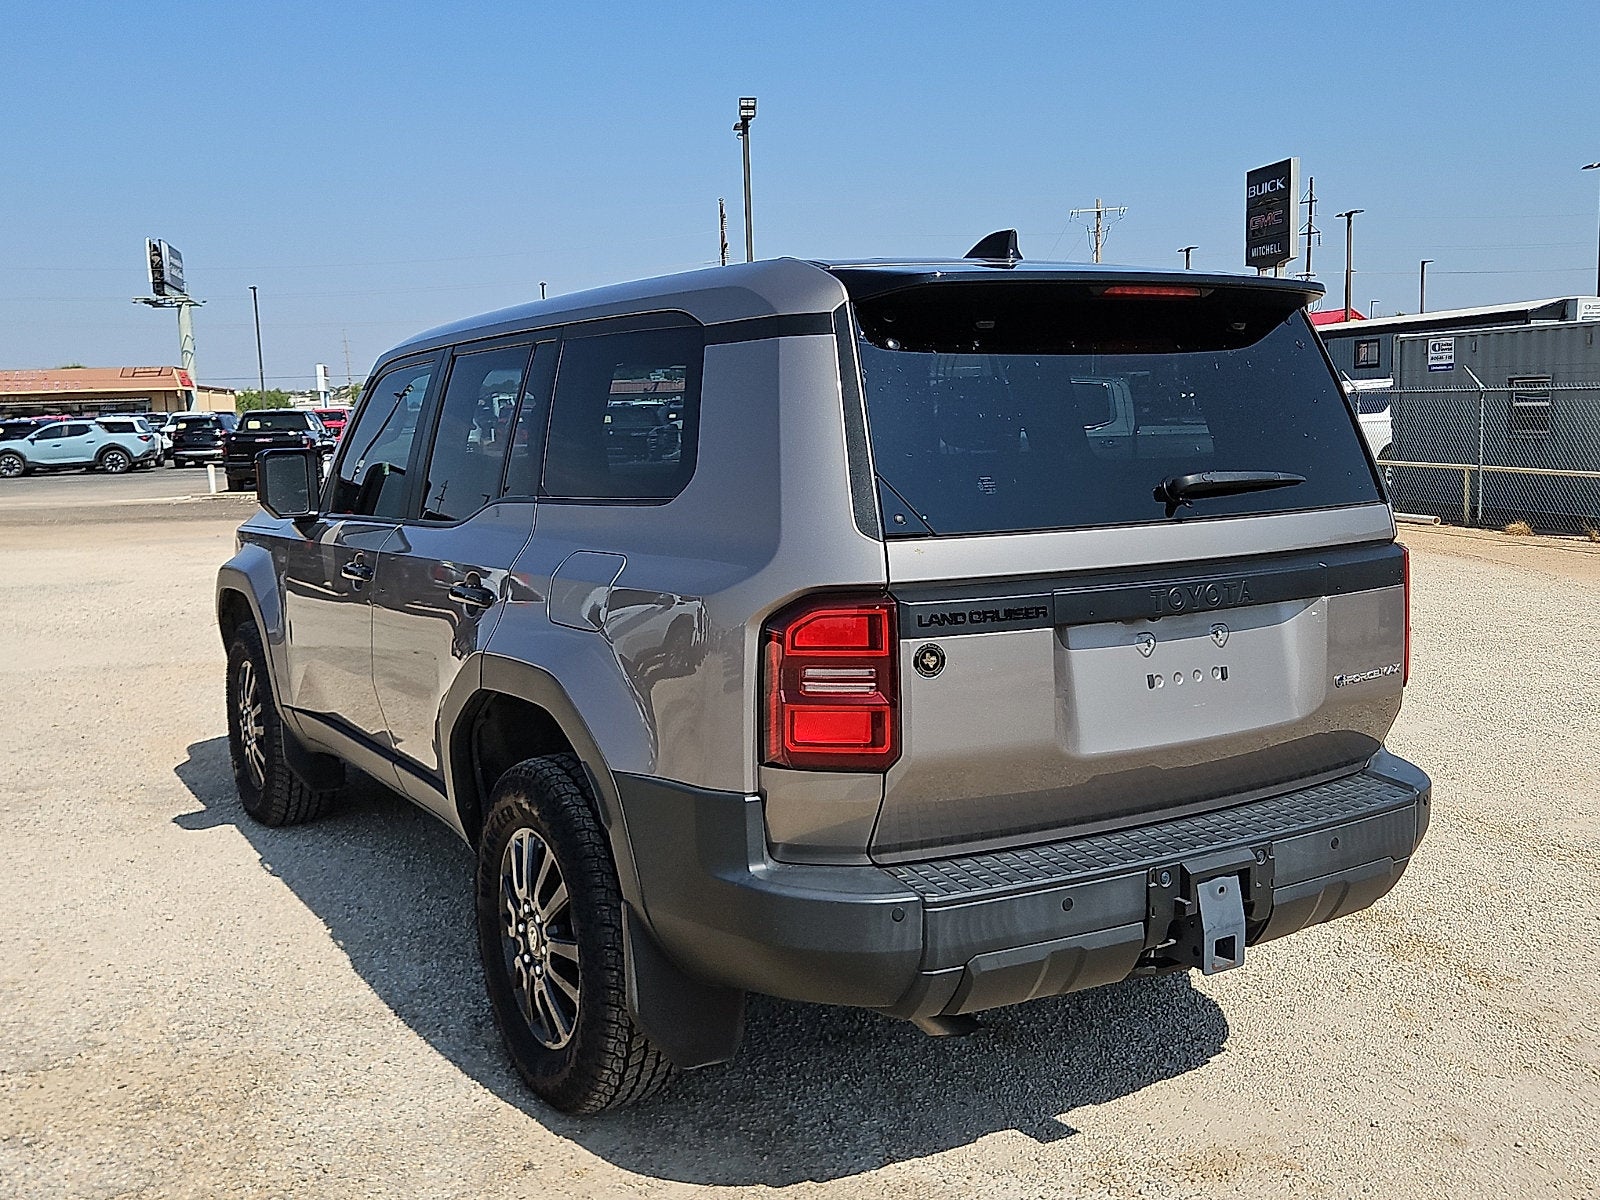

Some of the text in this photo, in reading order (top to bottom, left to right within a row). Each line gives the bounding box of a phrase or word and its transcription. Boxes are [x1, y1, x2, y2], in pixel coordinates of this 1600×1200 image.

[1247, 176, 1286, 199] BUICK
[1249, 209, 1283, 231] GMC
[1251, 242, 1282, 258] MITCHELL
[1150, 580, 1255, 613] TOYOTA
[916, 605, 1049, 628] LAND CRUISER
